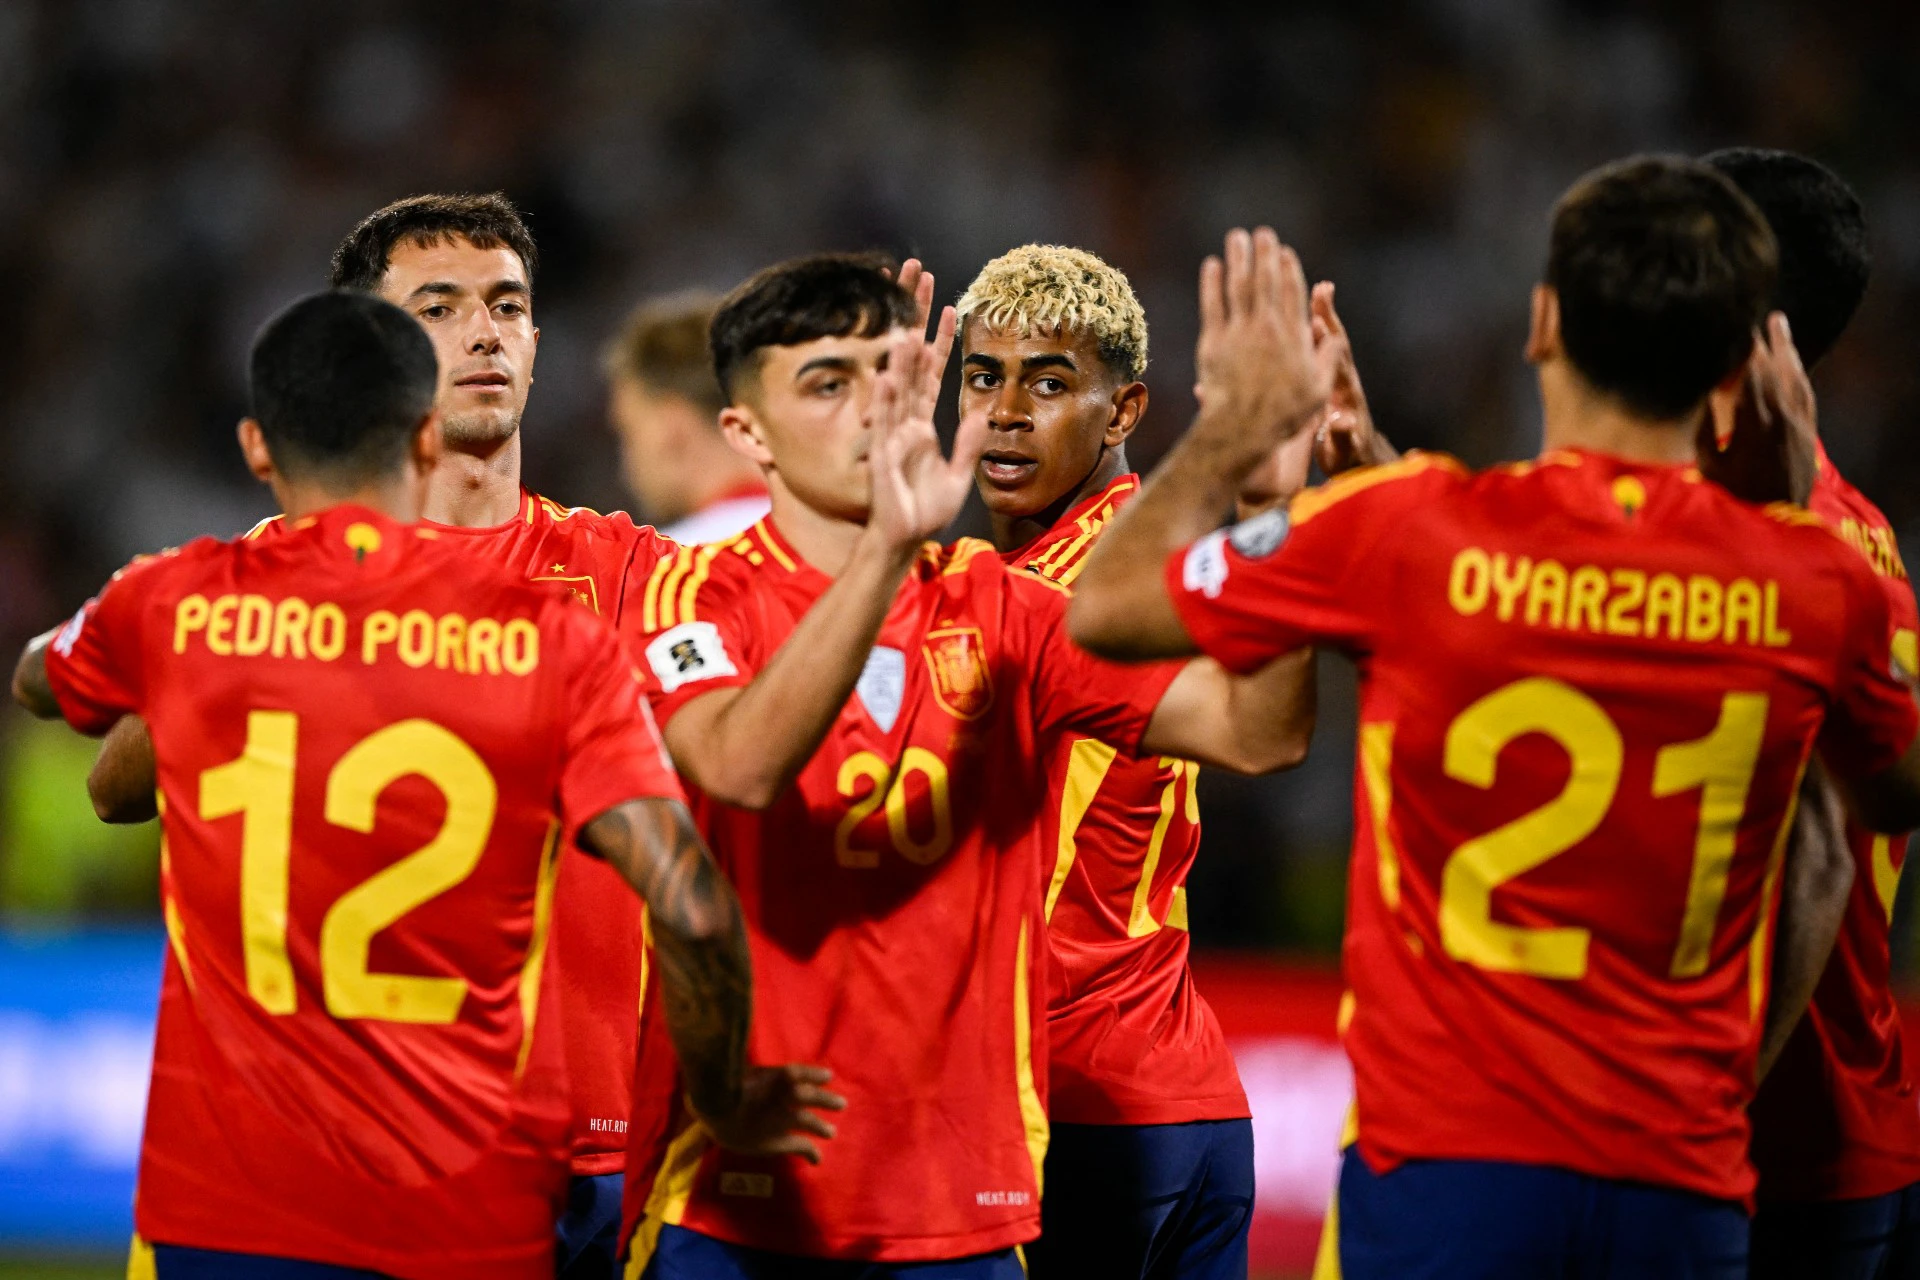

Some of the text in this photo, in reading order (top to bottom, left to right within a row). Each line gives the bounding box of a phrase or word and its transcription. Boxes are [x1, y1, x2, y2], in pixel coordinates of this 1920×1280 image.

[173, 593, 540, 677] PEDRO PORRO
[1449, 546, 1791, 647] OYARZABAL
[835, 747, 953, 869] 20
[1440, 677, 1769, 979] 21
[199, 710, 497, 1023] 12
[590, 1118, 628, 1133] HEAT.RDY
